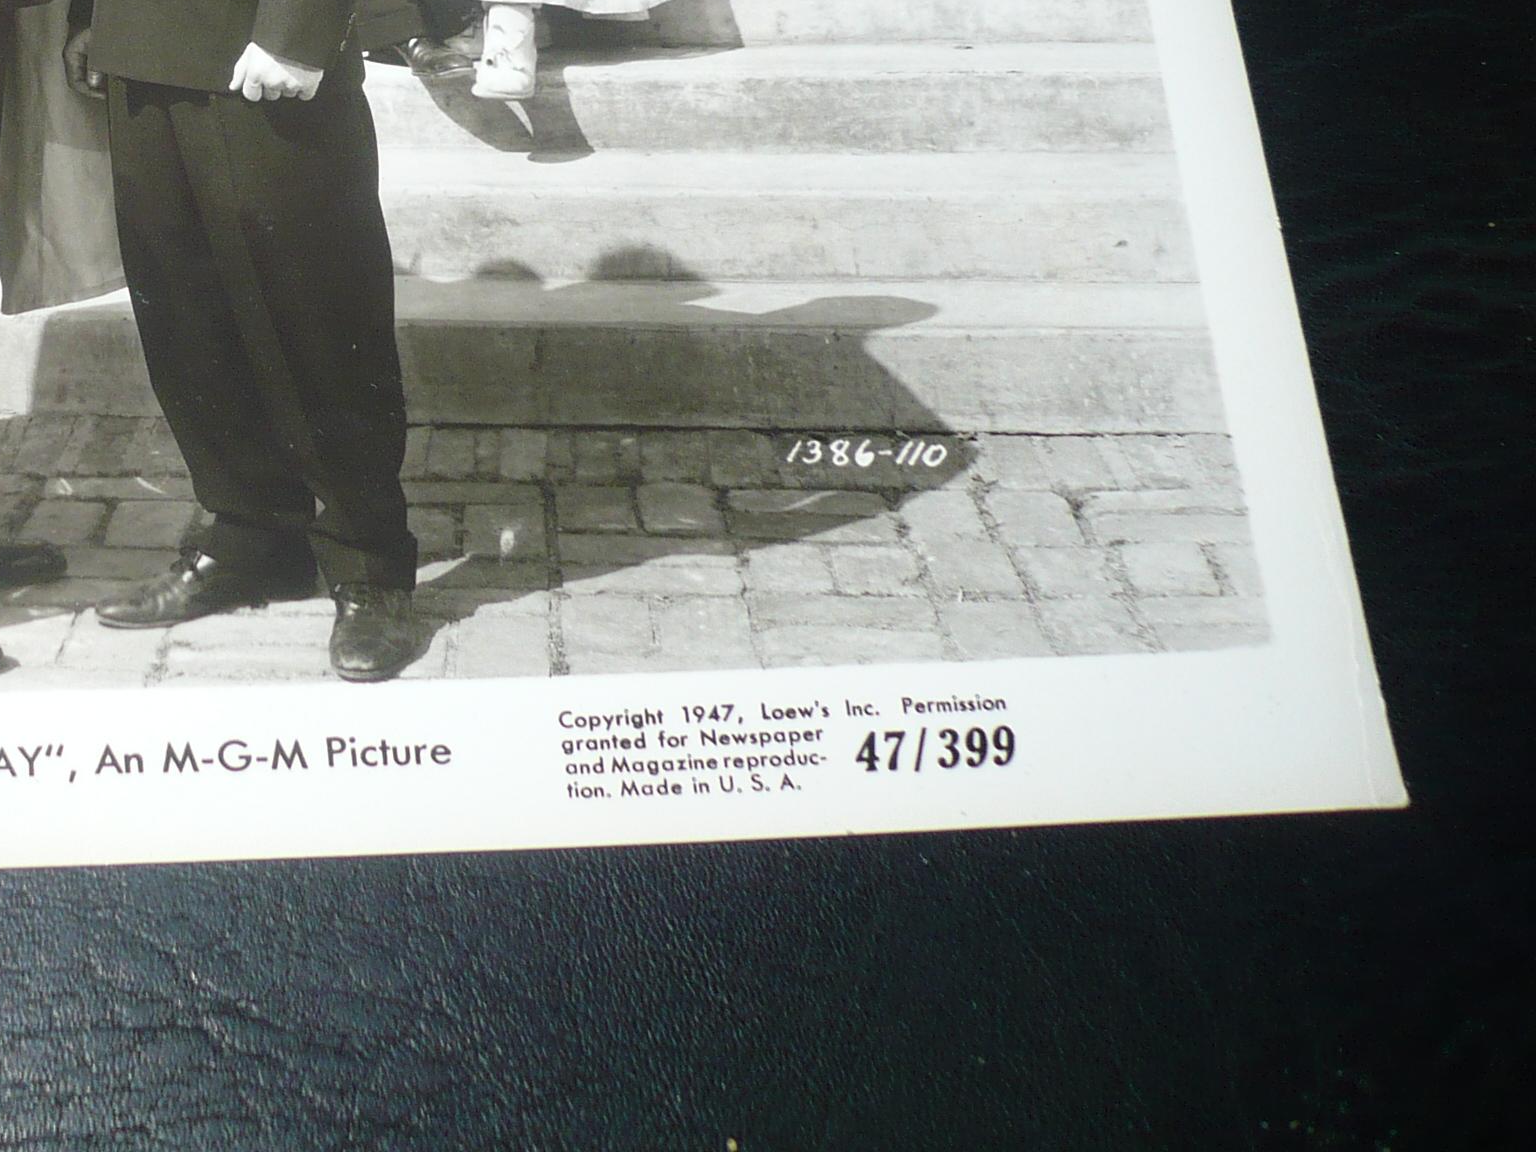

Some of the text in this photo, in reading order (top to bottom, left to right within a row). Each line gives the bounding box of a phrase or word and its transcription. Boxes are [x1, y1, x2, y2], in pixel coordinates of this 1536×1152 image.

[785, 438, 948, 467] 1386-110
[558, 693, 1007, 732] Copyright 1947, Loew's Inc. Permission
[94, 743, 145, 775] An
[162, 738, 309, 774] M-G-M
[325, 735, 452, 768] Picture
[561, 726, 823, 756] granted for Newspaper
[854, 724, 1017, 774] 47/399
[565, 748, 828, 777] and Magazine reproduc-
[567, 780, 612, 800] tion.
[620, 777, 683, 798] Made
[691, 776, 711, 795] in
